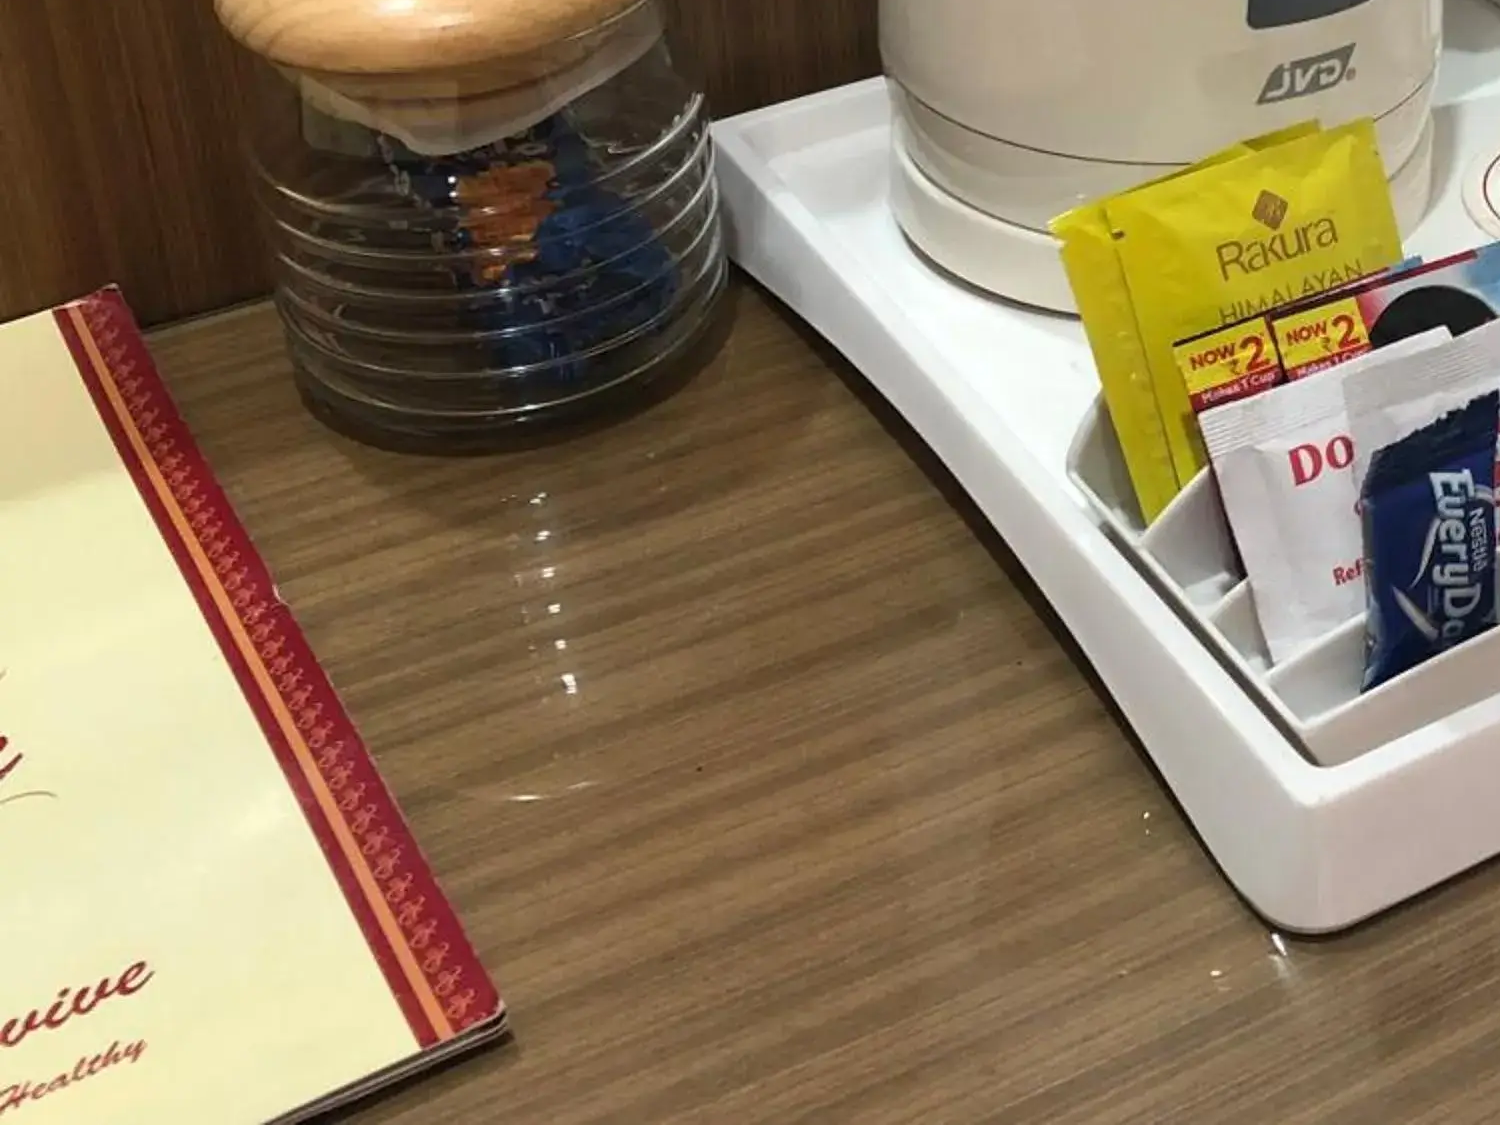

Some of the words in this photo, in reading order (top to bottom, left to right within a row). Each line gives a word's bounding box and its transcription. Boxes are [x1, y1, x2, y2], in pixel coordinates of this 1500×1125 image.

[1215, 217, 1339, 282] Rakura
[1218, 259, 1363, 324] HIMALAYAN
[1189, 342, 1237, 372] NOW
[1286, 321, 1328, 348] NOW
[0, 1038, 148, 1117] Healthy
